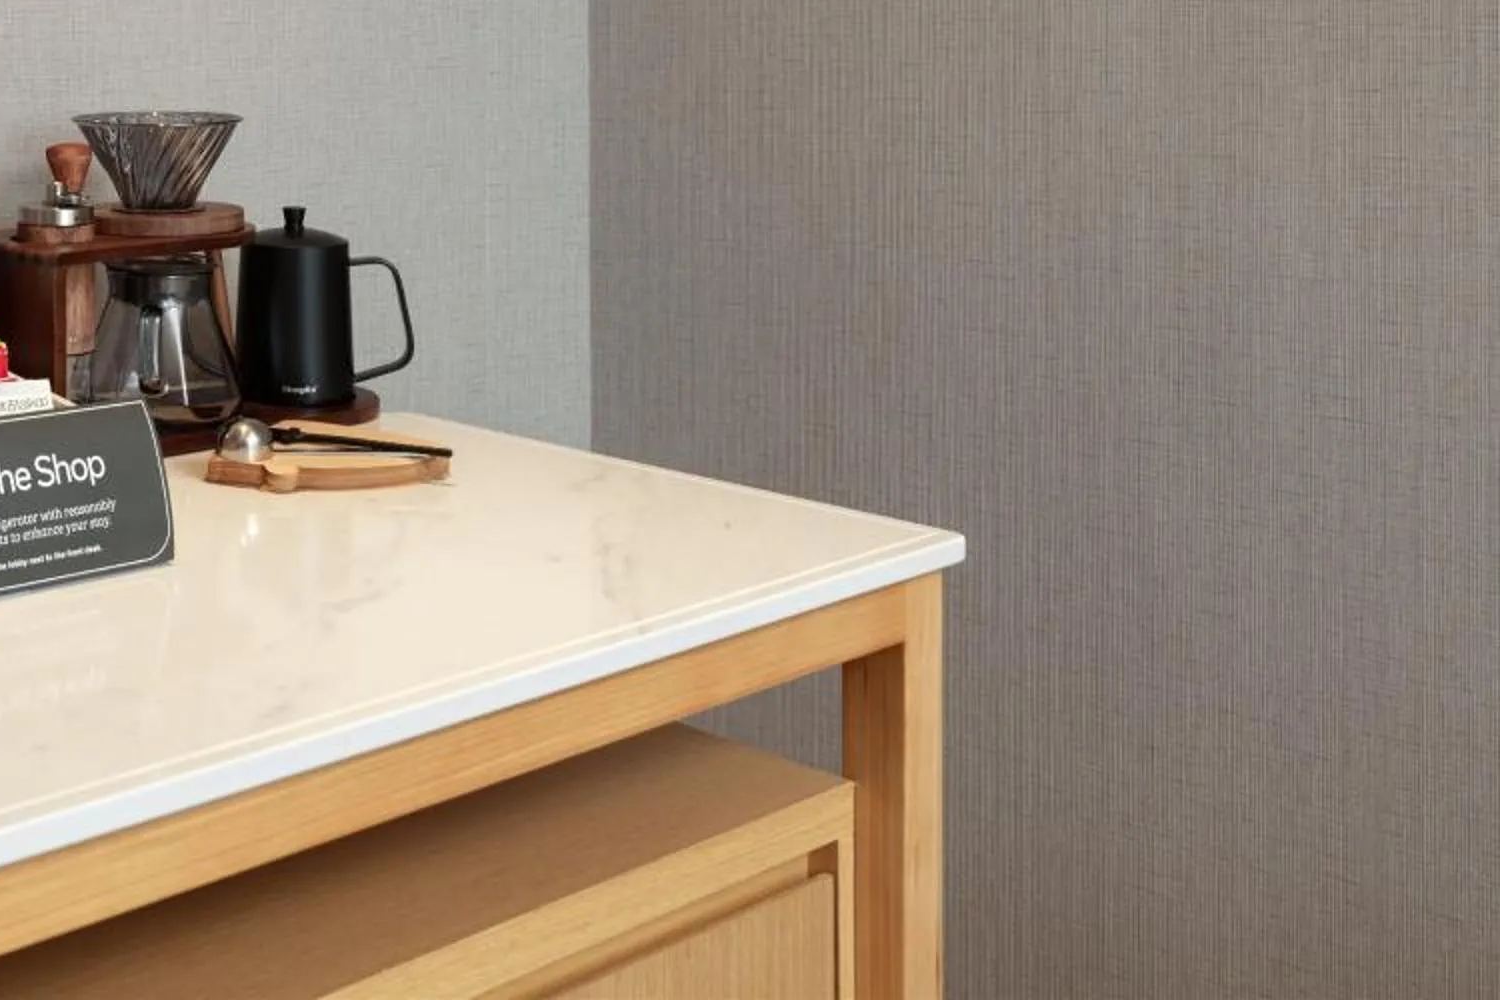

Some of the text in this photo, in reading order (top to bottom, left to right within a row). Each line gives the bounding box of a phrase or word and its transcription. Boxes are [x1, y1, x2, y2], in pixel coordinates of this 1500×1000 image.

[34, 453, 105, 488] Shop
[40, 507, 62, 522] with
[63, 498, 116, 518] reasonably
[9, 532, 21, 543] to
[23, 526, 64, 541] enhance
[65, 520, 88, 537] your
